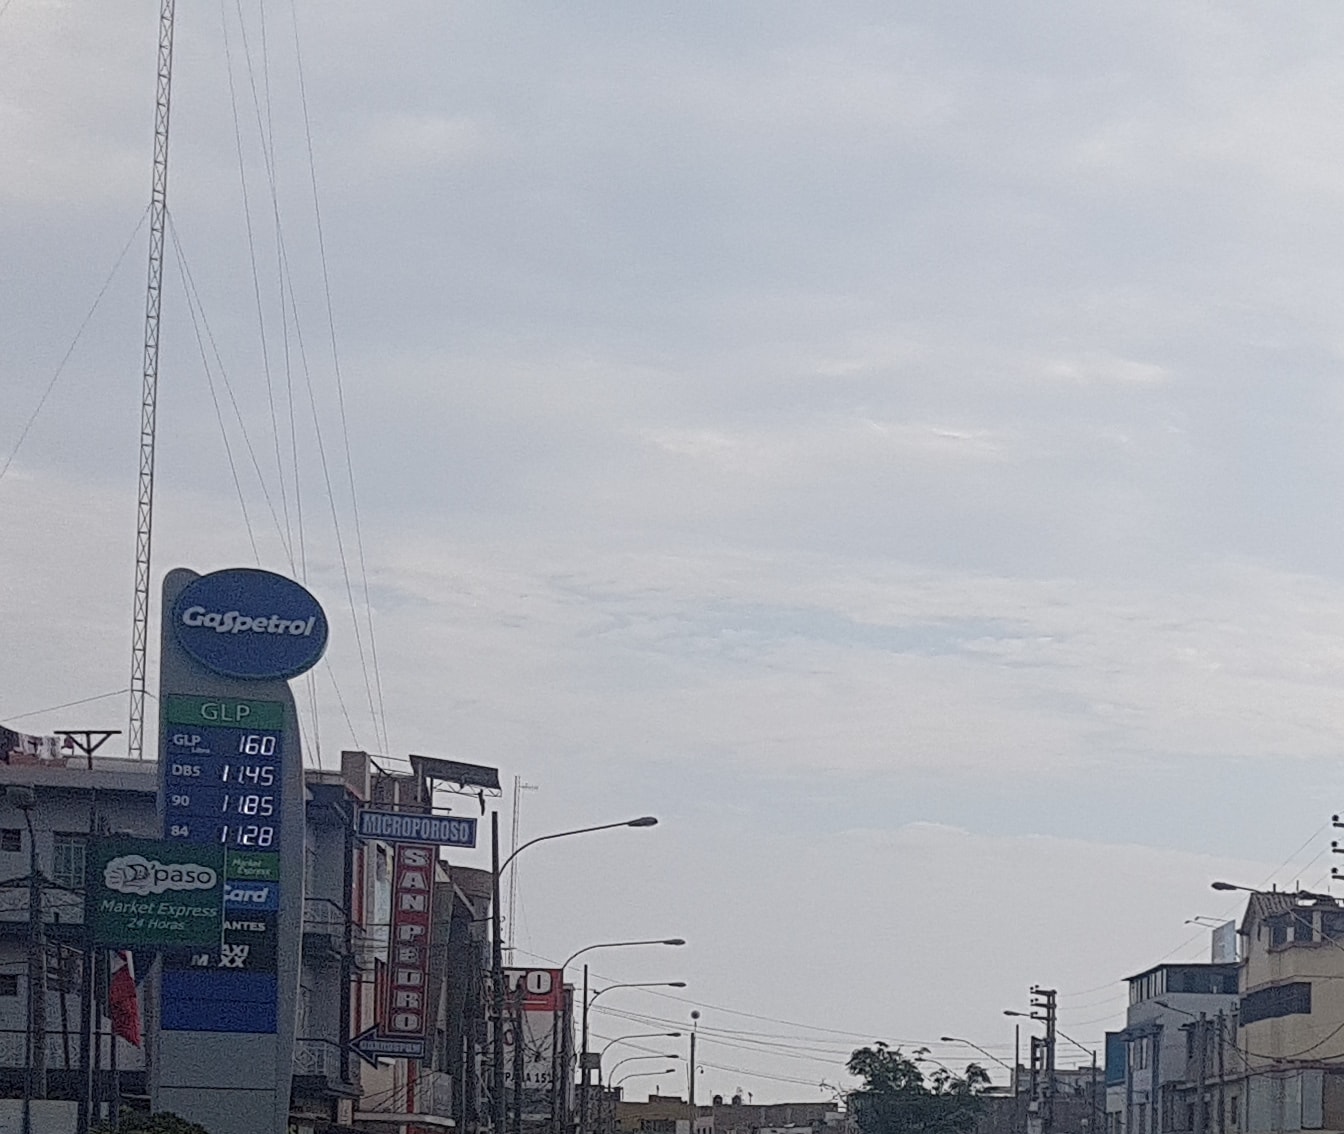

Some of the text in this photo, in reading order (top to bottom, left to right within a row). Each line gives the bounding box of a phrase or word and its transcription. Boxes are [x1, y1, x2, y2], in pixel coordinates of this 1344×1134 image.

[201, 703, 250, 721] GLP
[173, 734, 200, 746] GLP
[172, 795, 190, 806] 90
[171, 825, 189, 837] 84
[362, 813, 470, 841] MICROPOROSO
[101, 900, 218, 918] Market Express
[127, 918, 185, 930] 24 Horas
